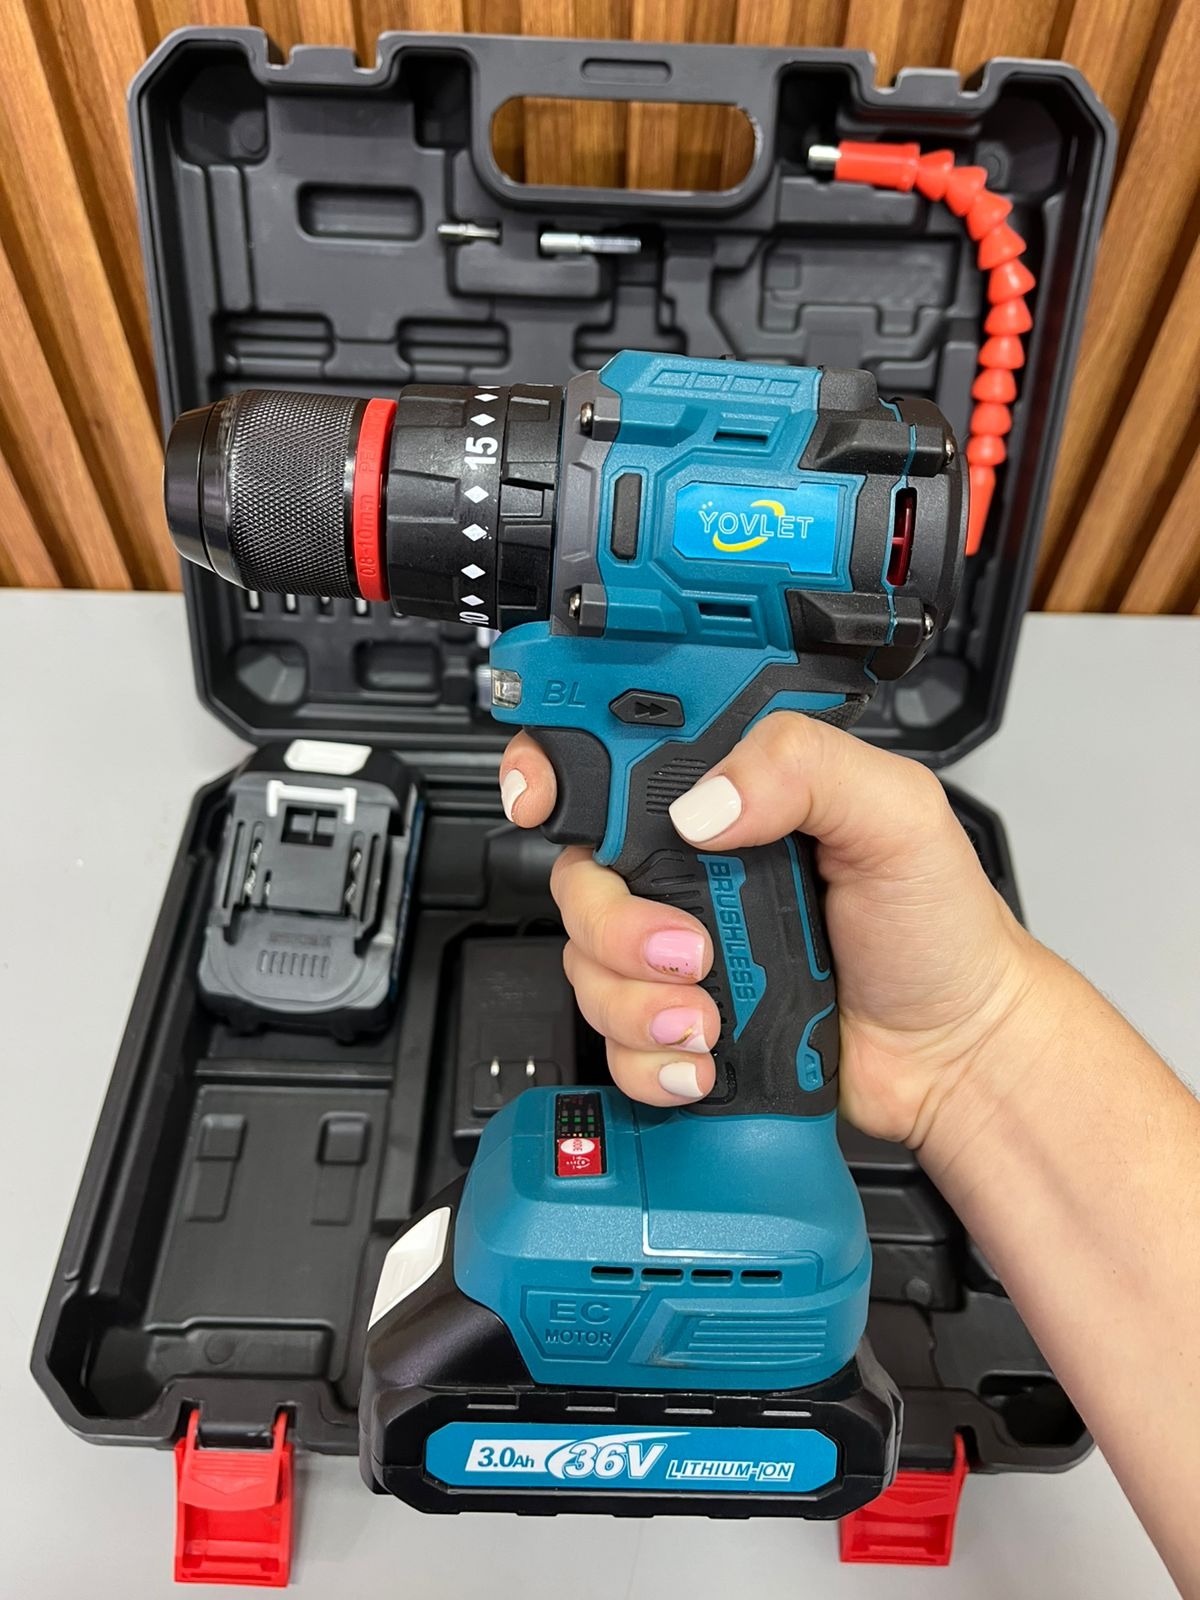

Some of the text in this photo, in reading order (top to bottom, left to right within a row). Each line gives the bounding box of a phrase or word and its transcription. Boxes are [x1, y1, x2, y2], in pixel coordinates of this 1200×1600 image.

[464, 437, 499, 471] 15
[459, 611, 489, 625] 10
[541, 680, 586, 708] BL
[709, 862, 757, 1001] BRUSHLESS
[549, 1300, 611, 1325] EC
[545, 1328, 612, 1347] MOTOR
[477, 1442, 795, 1482] 3.0Ah 36V LITHIUM-ION
